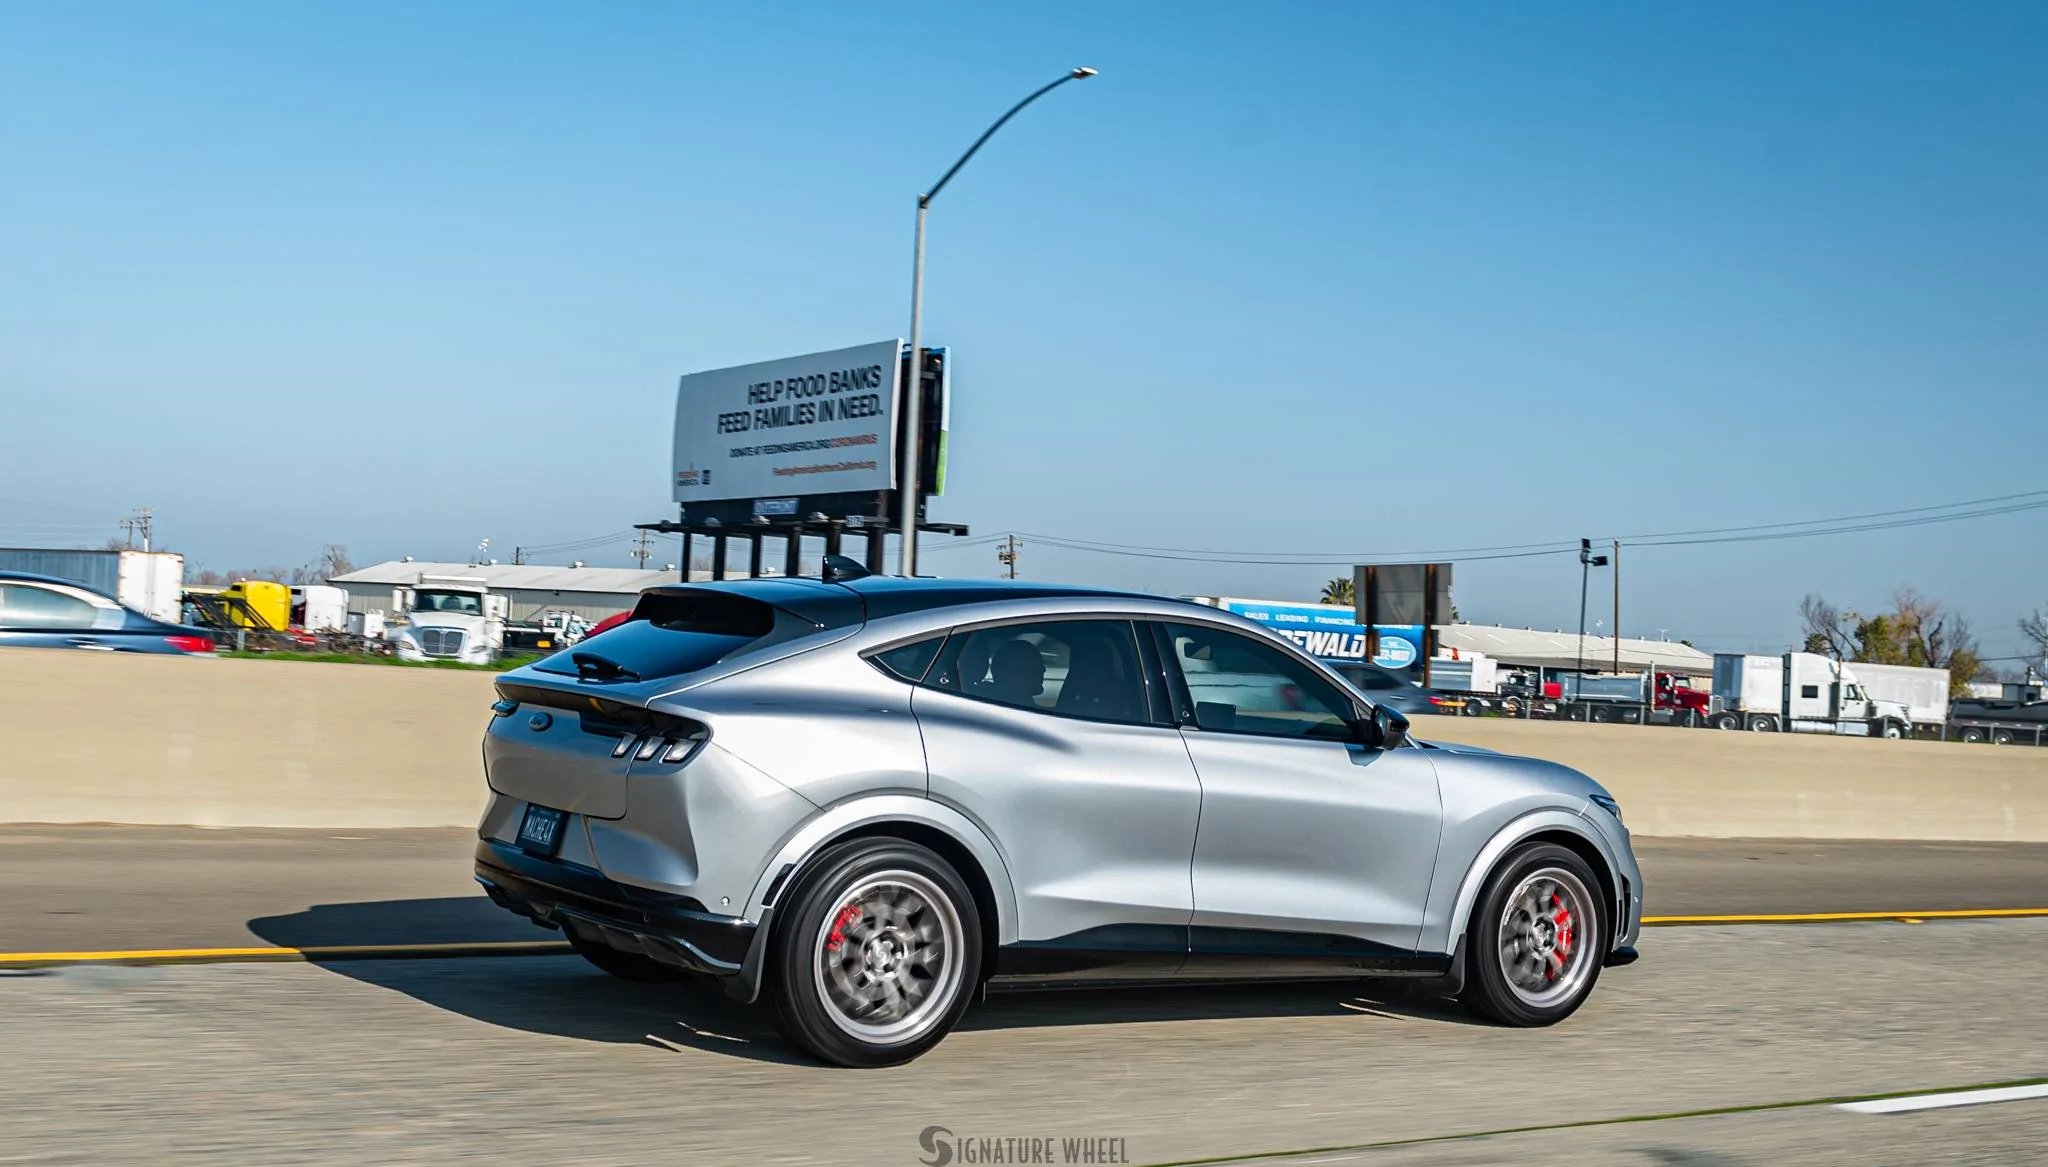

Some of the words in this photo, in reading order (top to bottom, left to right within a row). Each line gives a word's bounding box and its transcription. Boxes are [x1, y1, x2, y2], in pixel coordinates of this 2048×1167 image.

[747, 380, 784, 405] HELP
[785, 374, 827, 400] FOOD
[829, 365, 882, 394] BANKS
[717, 411, 751, 434] FEED
[753, 402, 816, 430] FAMILIES
[818, 400, 835, 422] IN
[837, 393, 884, 420] NEED.
[1244, 611, 1269, 620] SALES
[1275, 614, 1309, 623] LEASING
